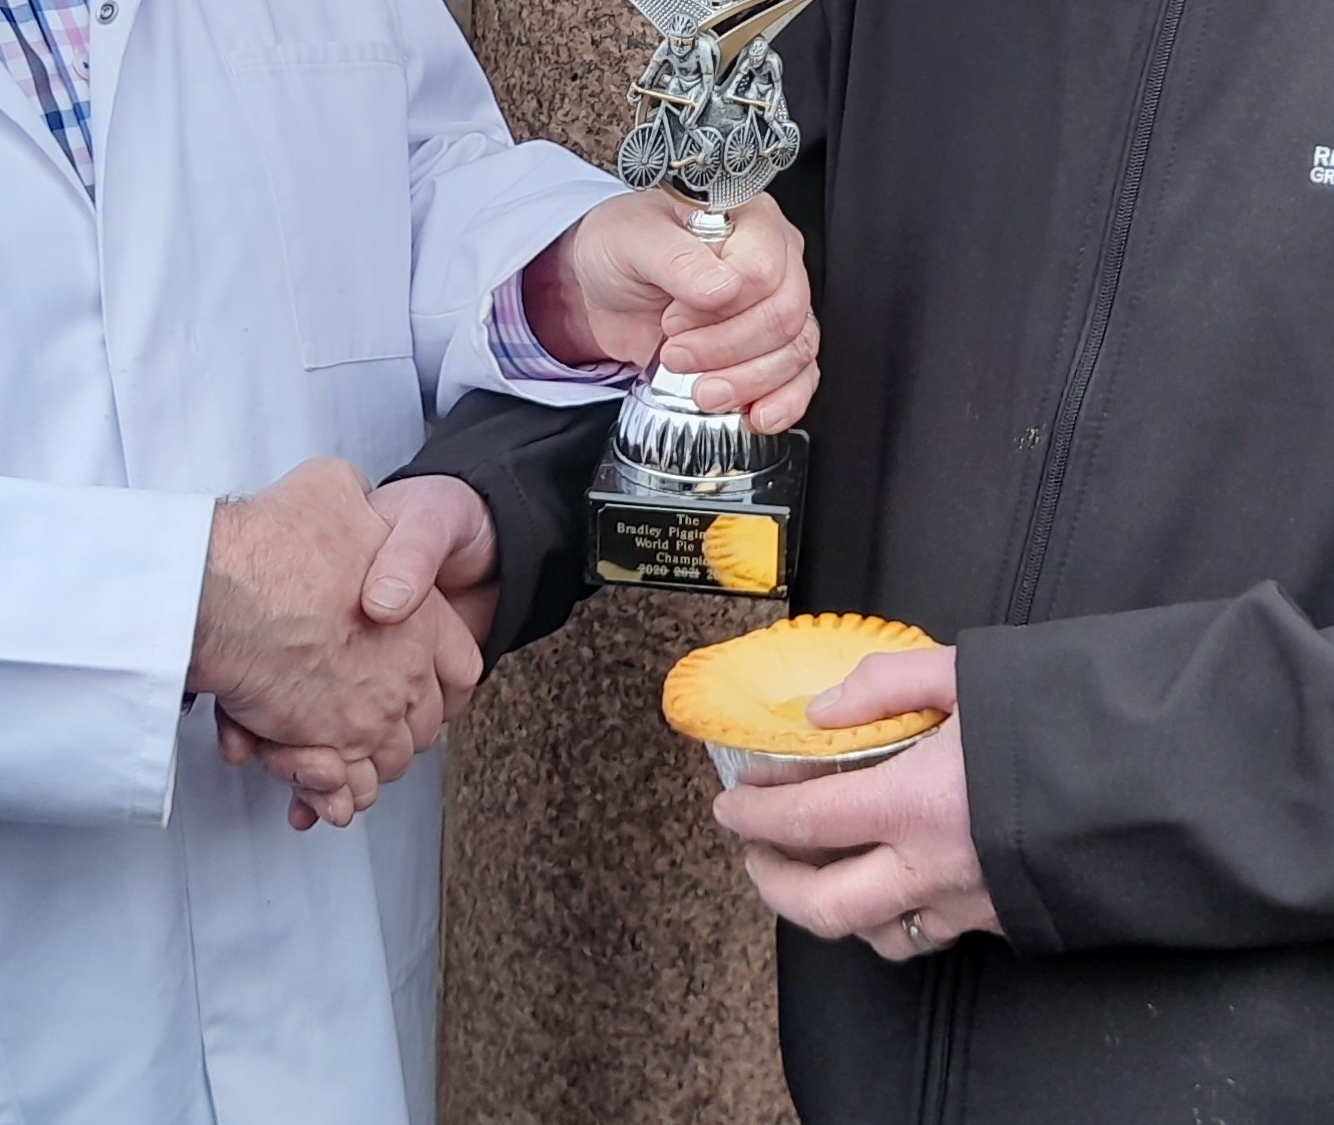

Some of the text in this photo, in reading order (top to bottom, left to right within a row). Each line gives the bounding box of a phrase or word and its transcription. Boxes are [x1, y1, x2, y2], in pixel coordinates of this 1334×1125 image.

[676, 513, 700, 526] The
[617, 522, 662, 537] Bradley
[635, 537, 669, 549] World
[676, 540, 695, 551] Pie
